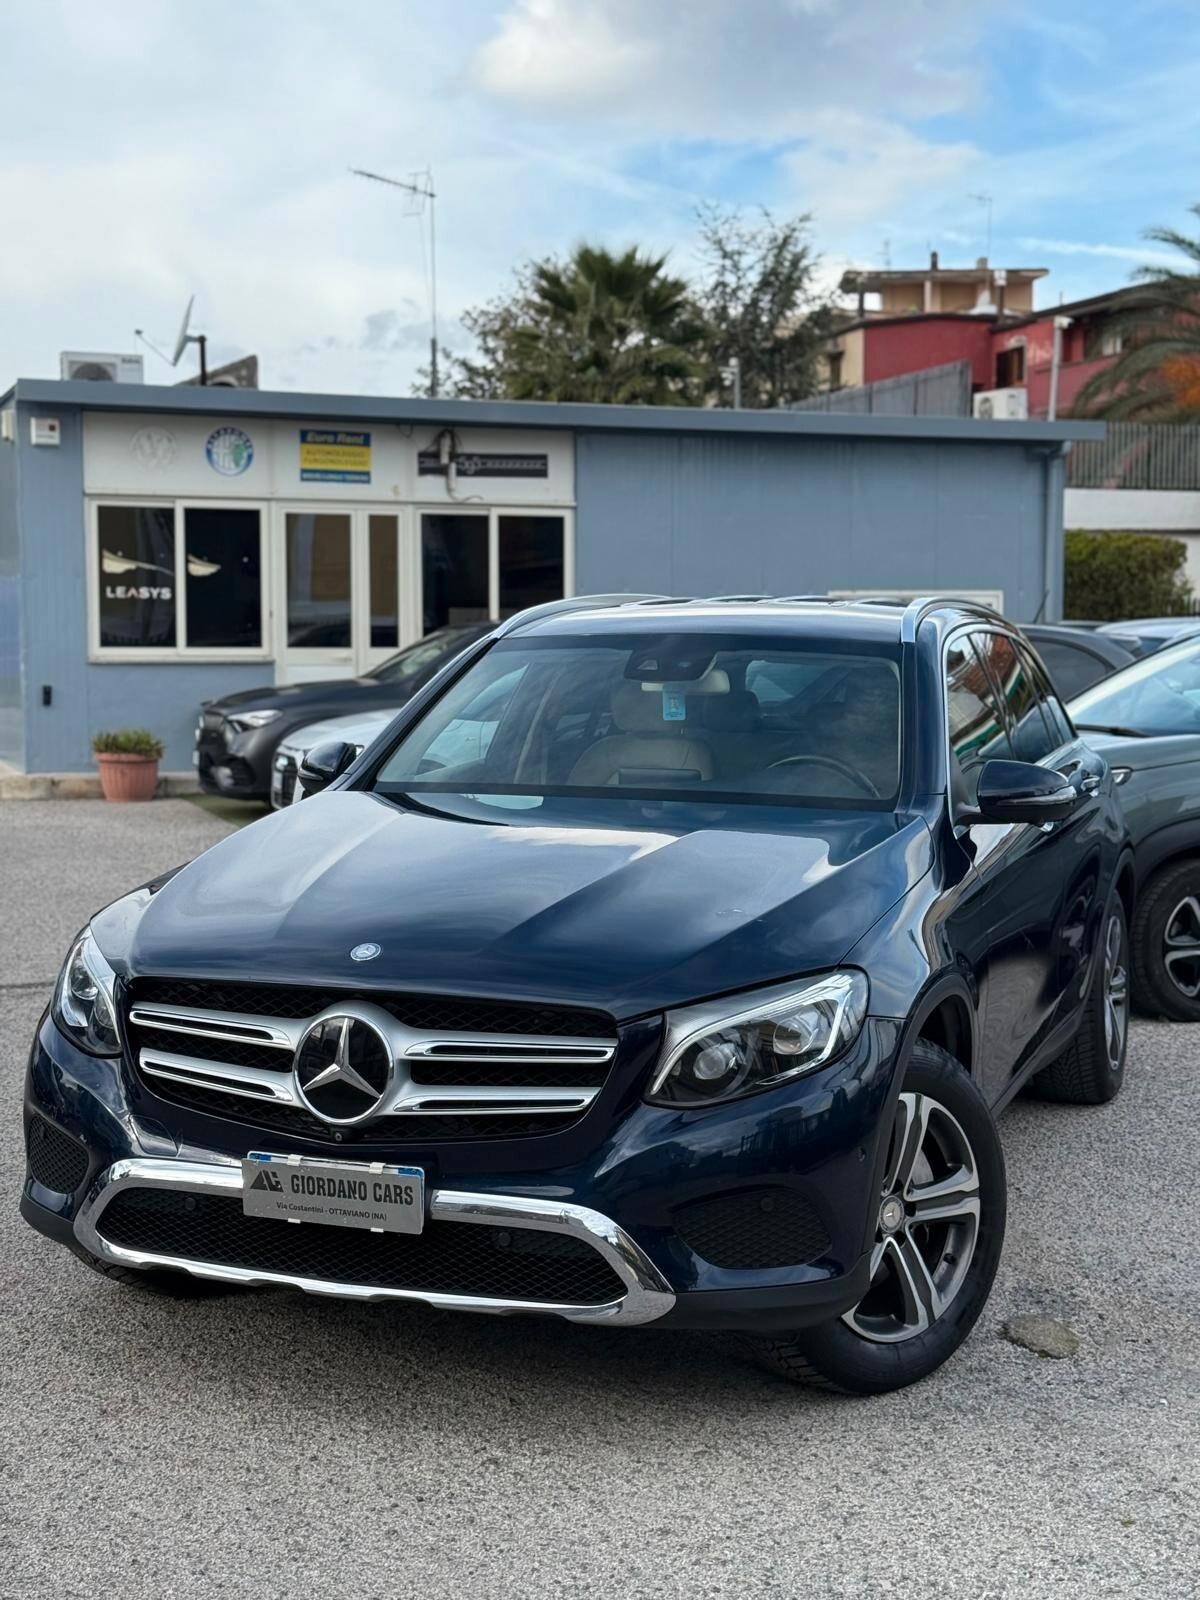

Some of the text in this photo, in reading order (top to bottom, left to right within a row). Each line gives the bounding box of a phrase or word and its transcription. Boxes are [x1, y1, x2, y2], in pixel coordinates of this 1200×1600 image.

[105, 585, 172, 600] LEASYS
[290, 1174, 414, 1206] GIORDANO CARS
[276, 1201, 288, 1210] Via
[288, 1203, 324, 1214] Costantini
[328, 1207, 371, 1219] OTTAVIANO
[371, 1212, 387, 1221] (NA)
